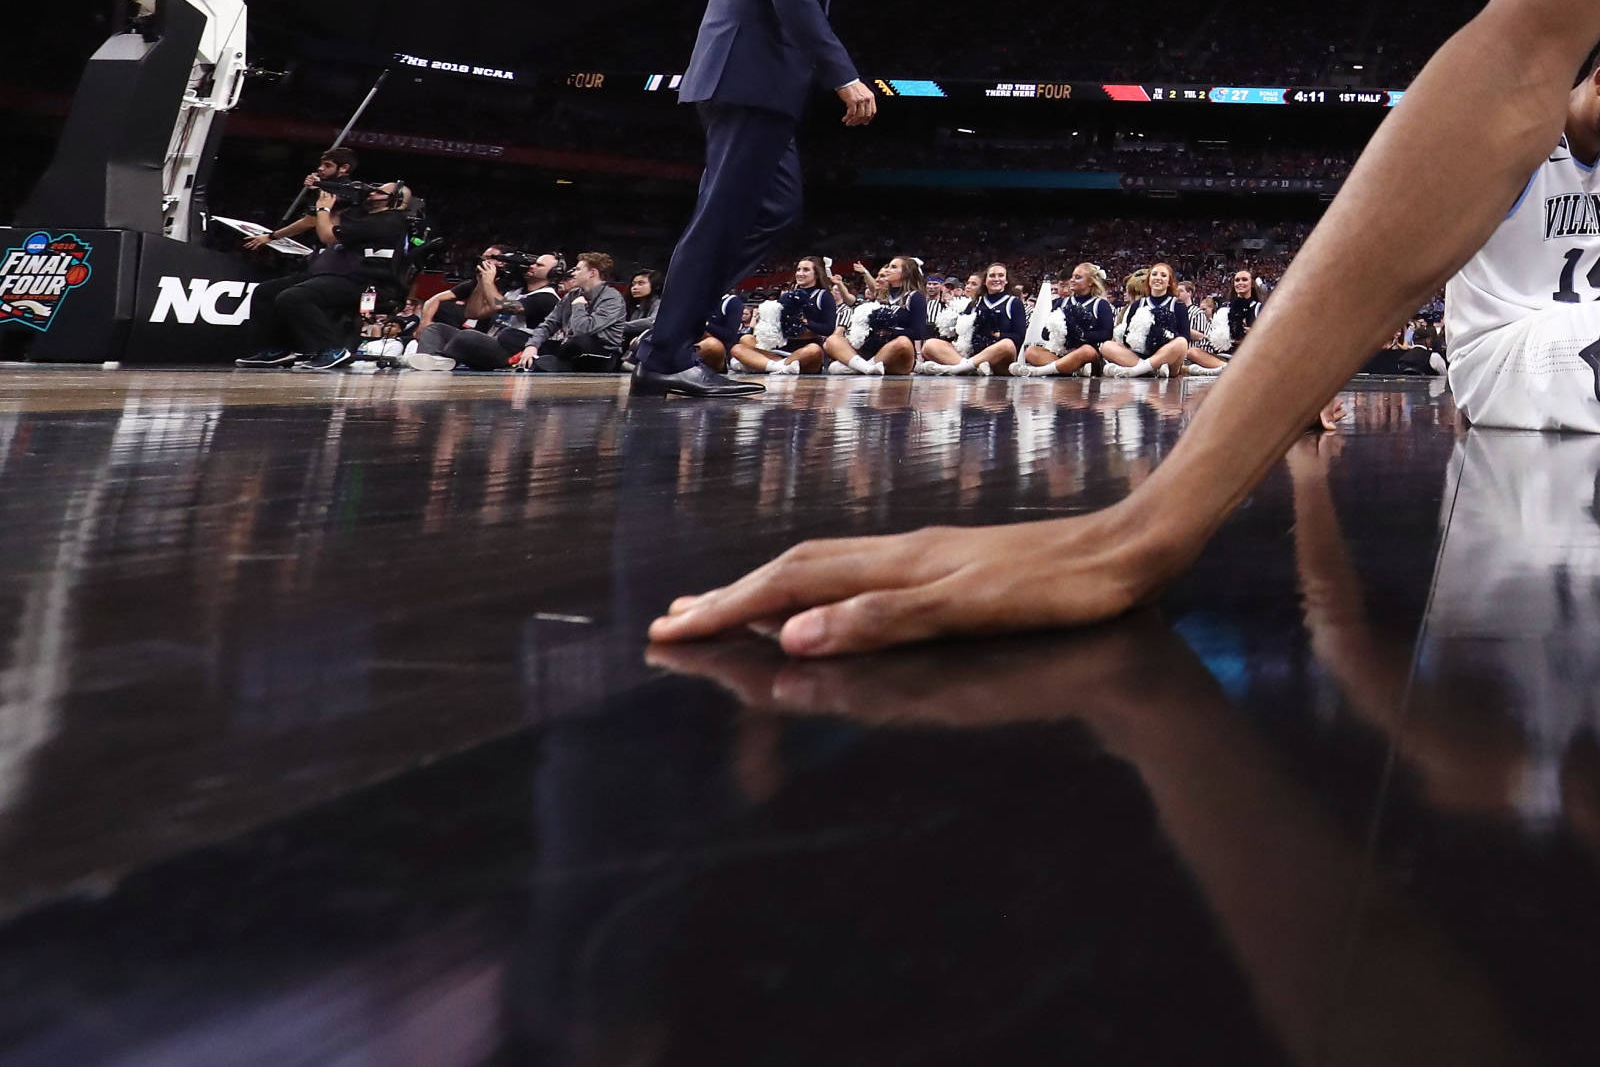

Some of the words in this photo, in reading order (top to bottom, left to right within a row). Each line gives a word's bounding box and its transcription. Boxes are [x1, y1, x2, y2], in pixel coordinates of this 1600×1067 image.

[431, 61, 470, 73] 2018
[473, 66, 514, 79] NCAA
[1036, 84, 1072, 98] FOUR
[1169, 90, 1177, 99] 2
[1198, 90, 1206, 99] 2
[1231, 89, 1249, 100] 27
[1294, 91, 1325, 103] 4:11
[1338, 93, 1356, 102] 1ST
[1357, 94, 1382, 102] HALF
[0, 252, 73, 276] FINAL
[0, 275, 67, 297] FOUR
